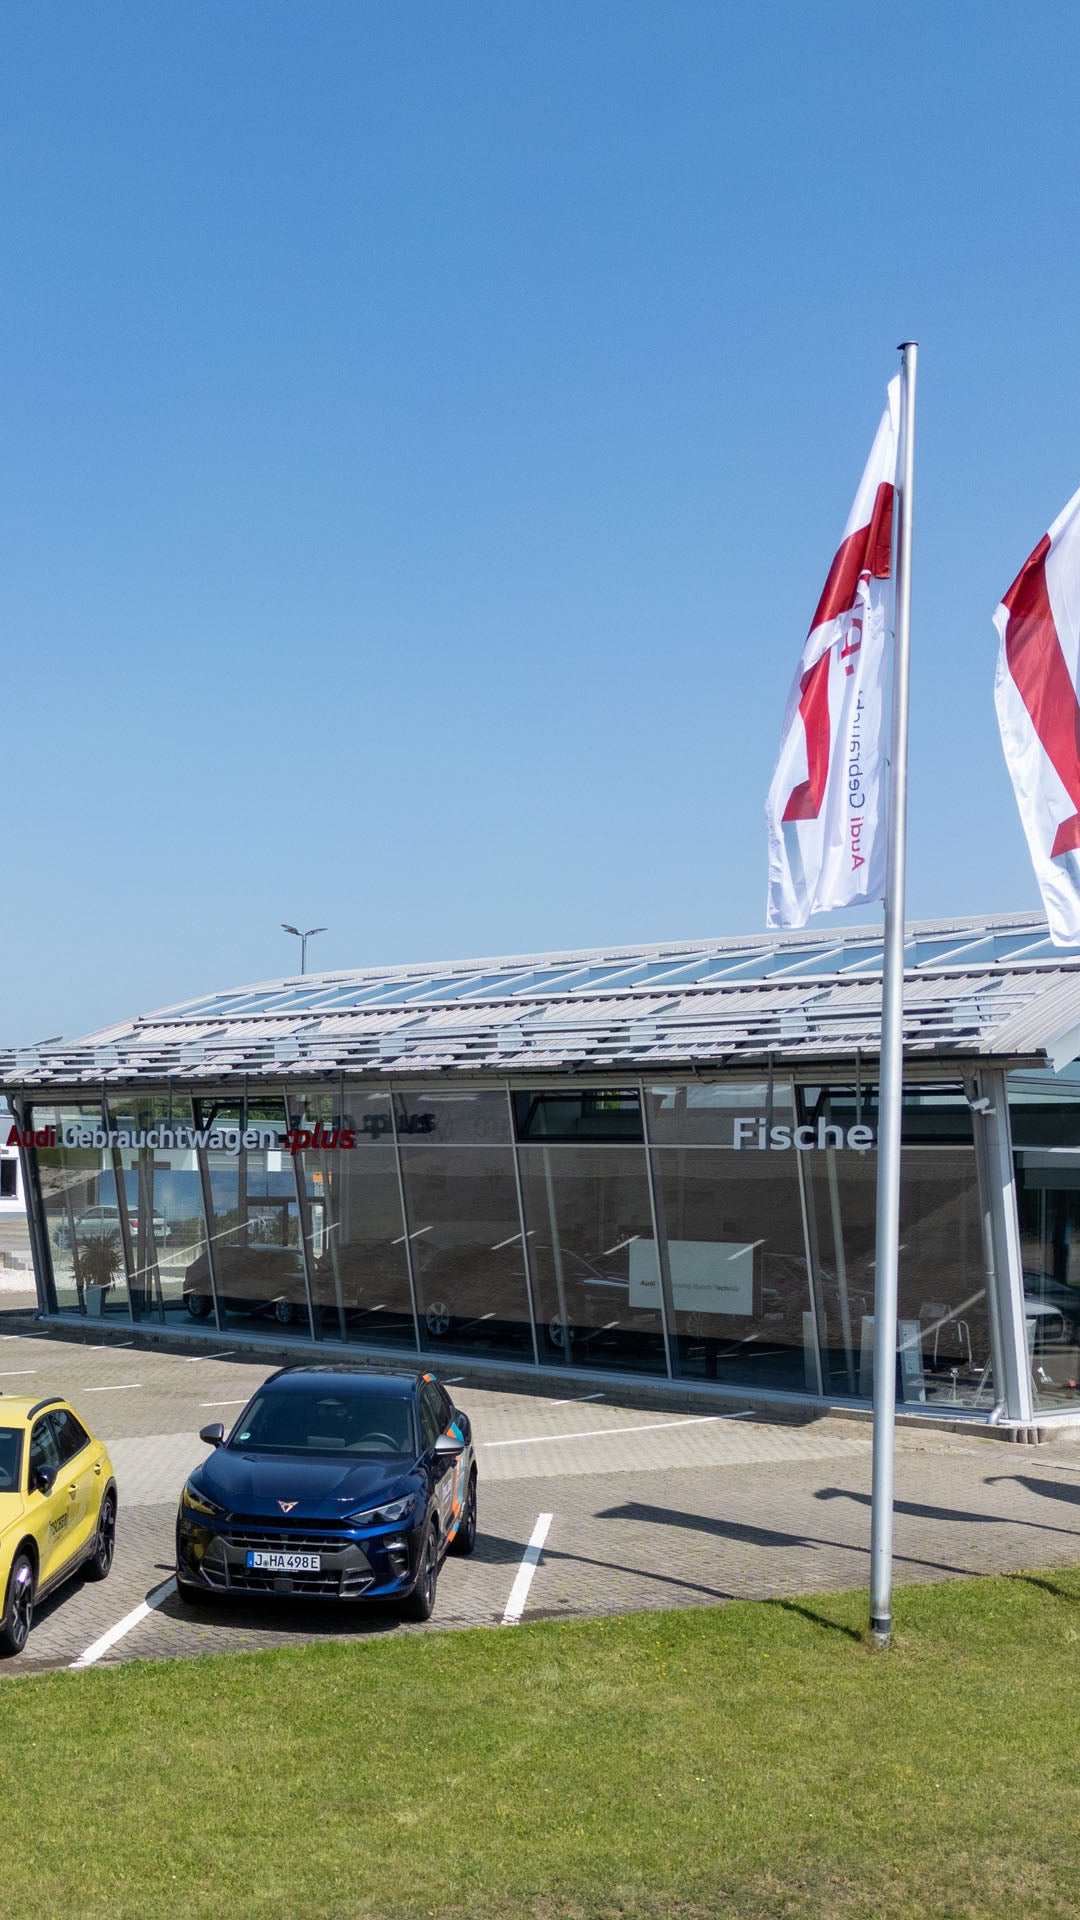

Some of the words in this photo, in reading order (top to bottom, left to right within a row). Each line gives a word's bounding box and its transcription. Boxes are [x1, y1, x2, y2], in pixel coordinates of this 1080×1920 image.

[6, 1124, 56, 1148] Audi
[62, 1123, 277, 1156] Gebrauchtwagen
[285, 1122, 356, 1156] :plus
[733, 1116, 880, 1150] Fische
[255, 1554, 263, 1566] J
[269, 1555, 285, 1567] HA
